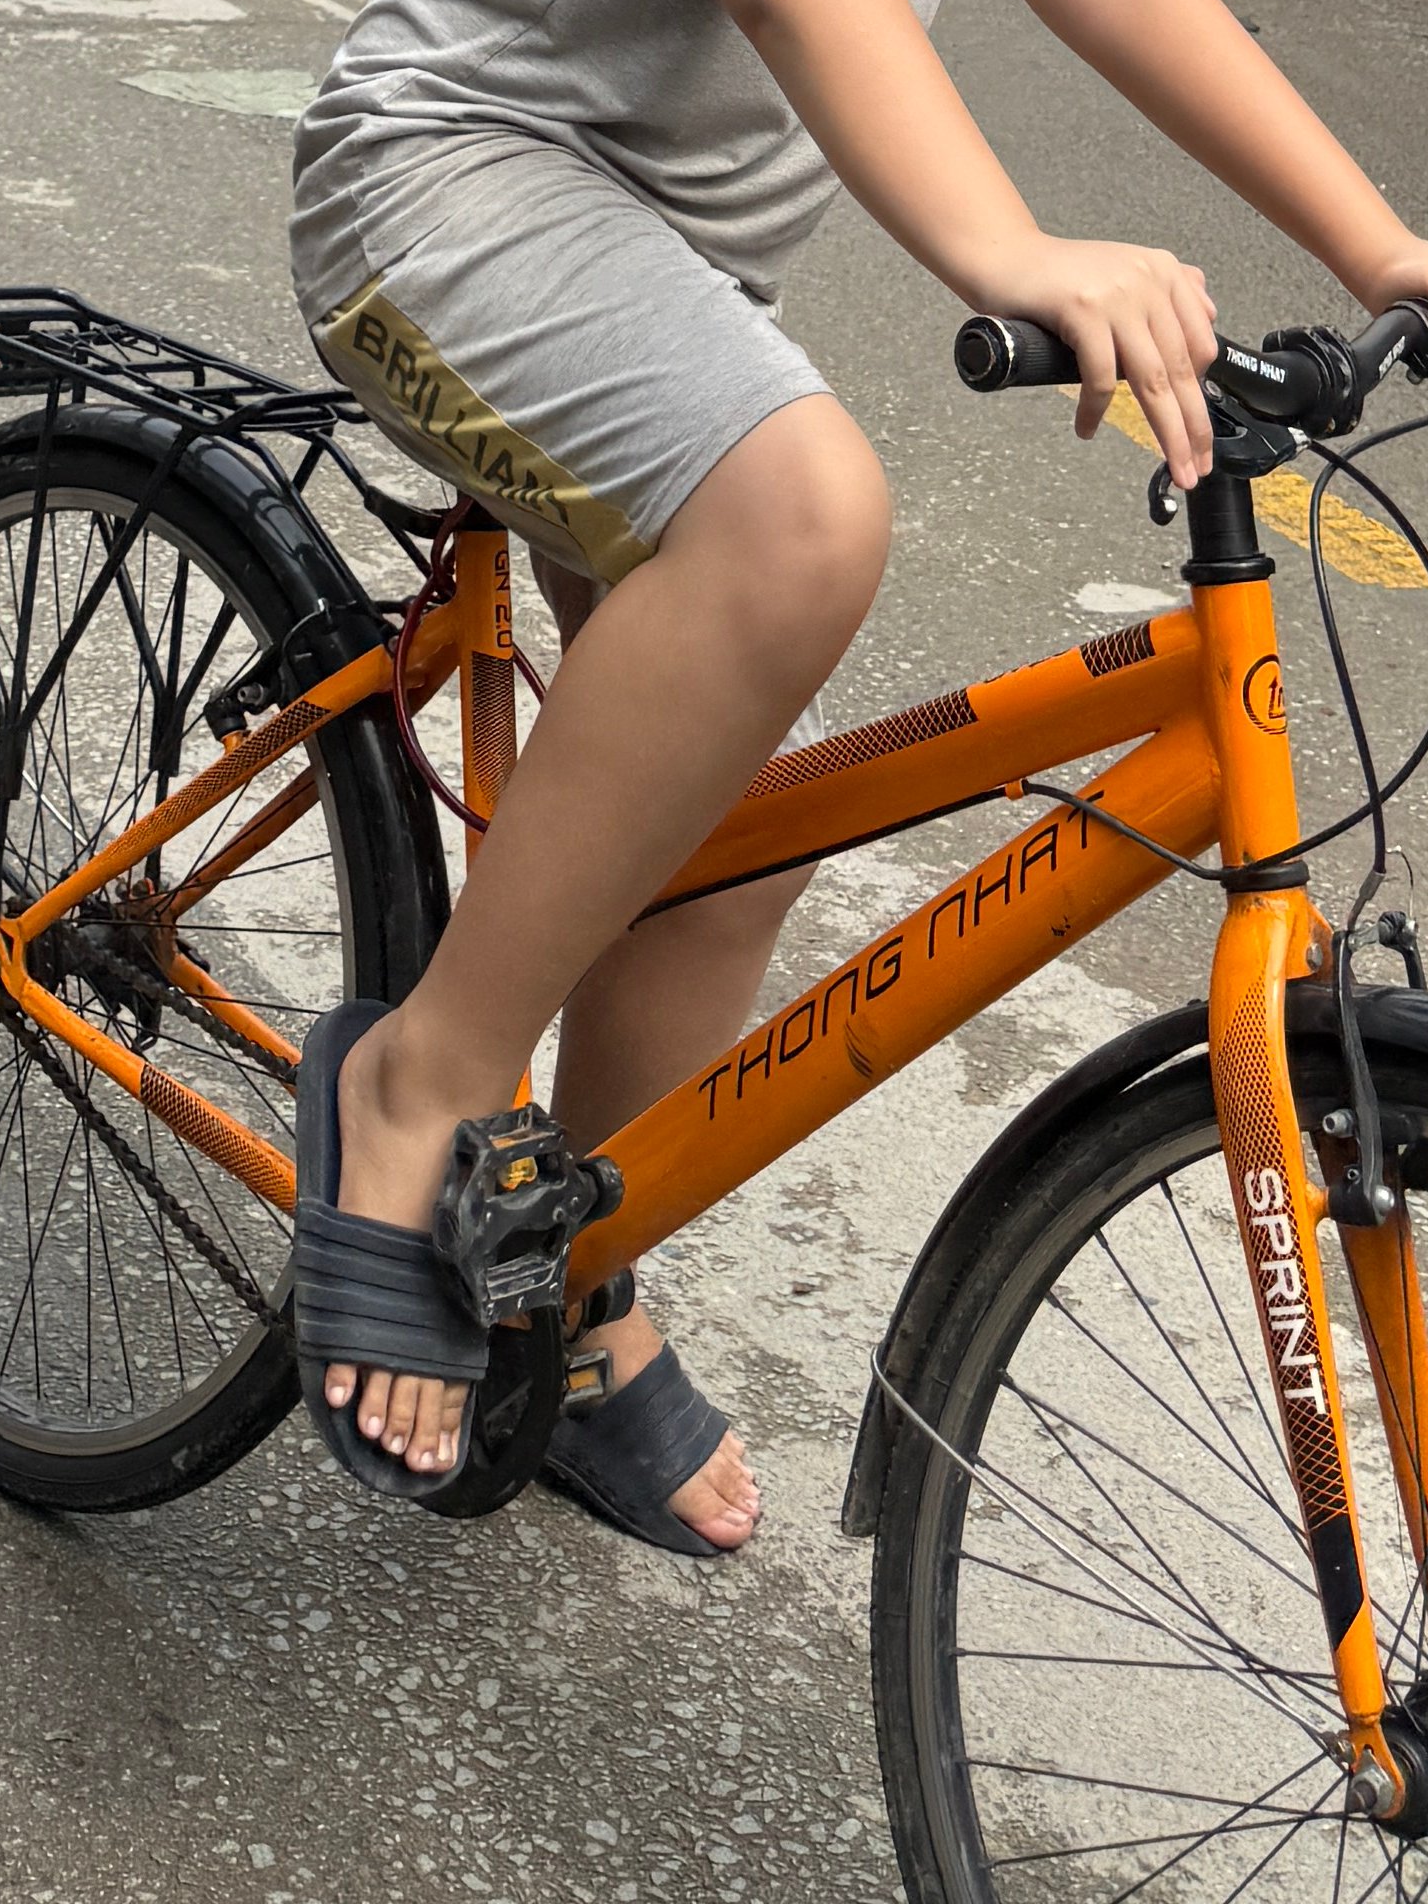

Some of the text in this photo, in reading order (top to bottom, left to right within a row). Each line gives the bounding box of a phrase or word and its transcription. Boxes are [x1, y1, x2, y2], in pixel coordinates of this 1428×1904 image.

[698, 789, 1107, 1122] THONG NHAT
[1241, 1167, 1329, 1417] SPRINT
